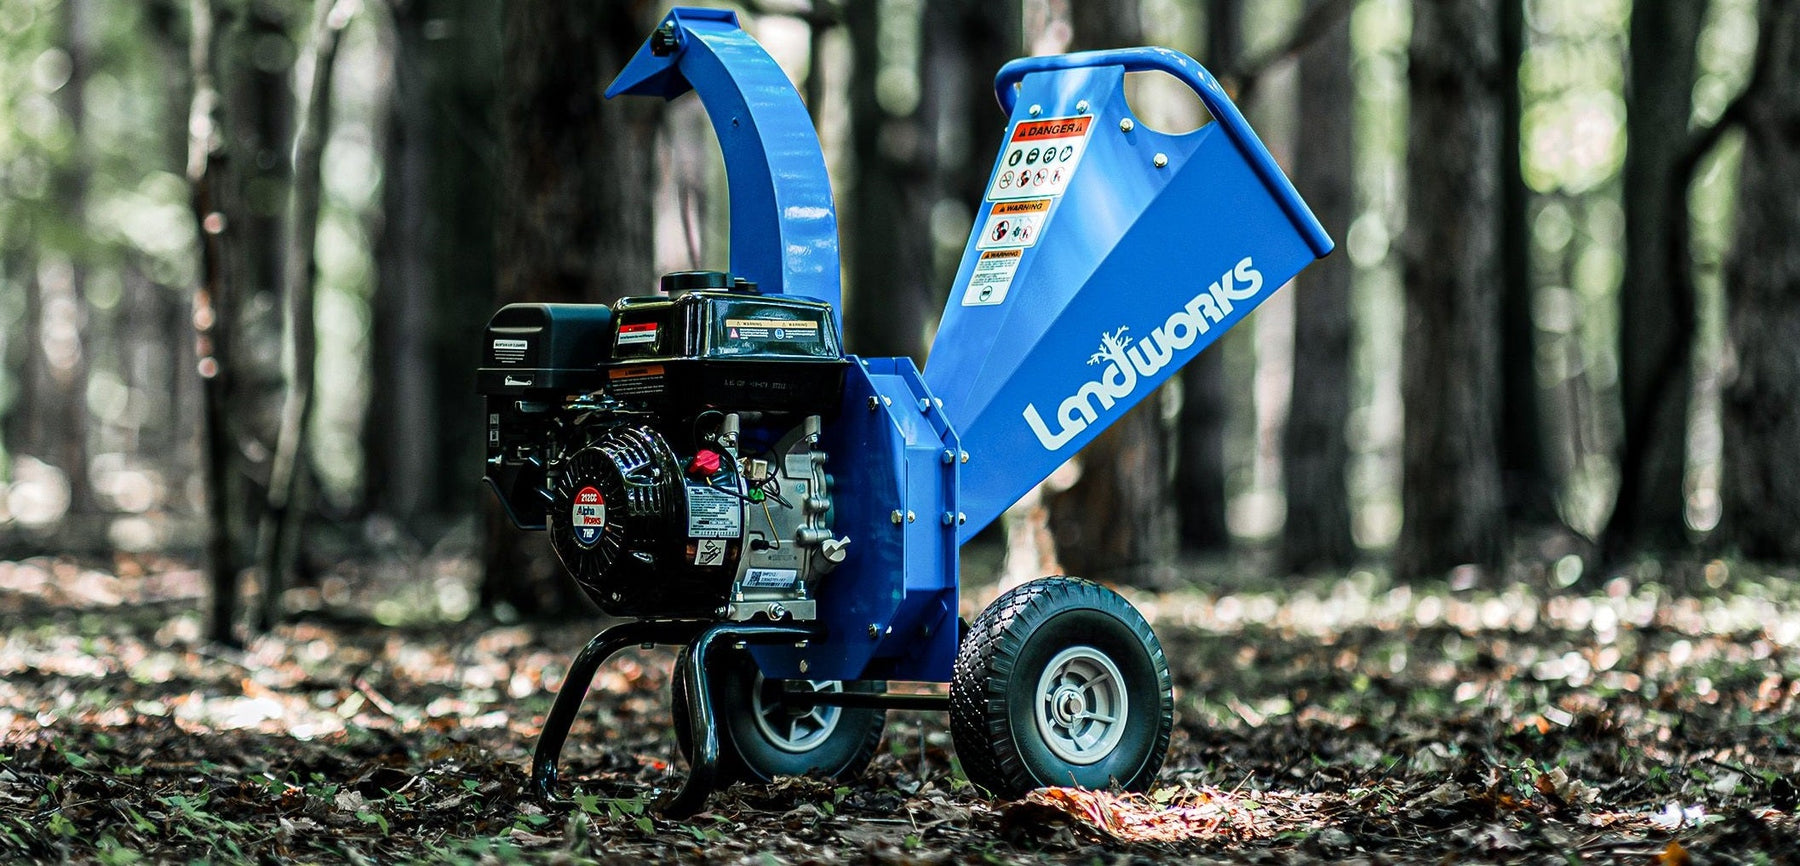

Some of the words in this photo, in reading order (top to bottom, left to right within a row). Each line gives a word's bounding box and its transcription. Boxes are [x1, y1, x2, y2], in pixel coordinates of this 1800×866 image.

[1027, 123, 1075, 137] DANGER
[1006, 202, 1043, 211] WARNING
[990, 250, 1018, 258] WARNING
[581, 493, 598, 502] 212CC
[582, 528, 595, 538] 7HP
